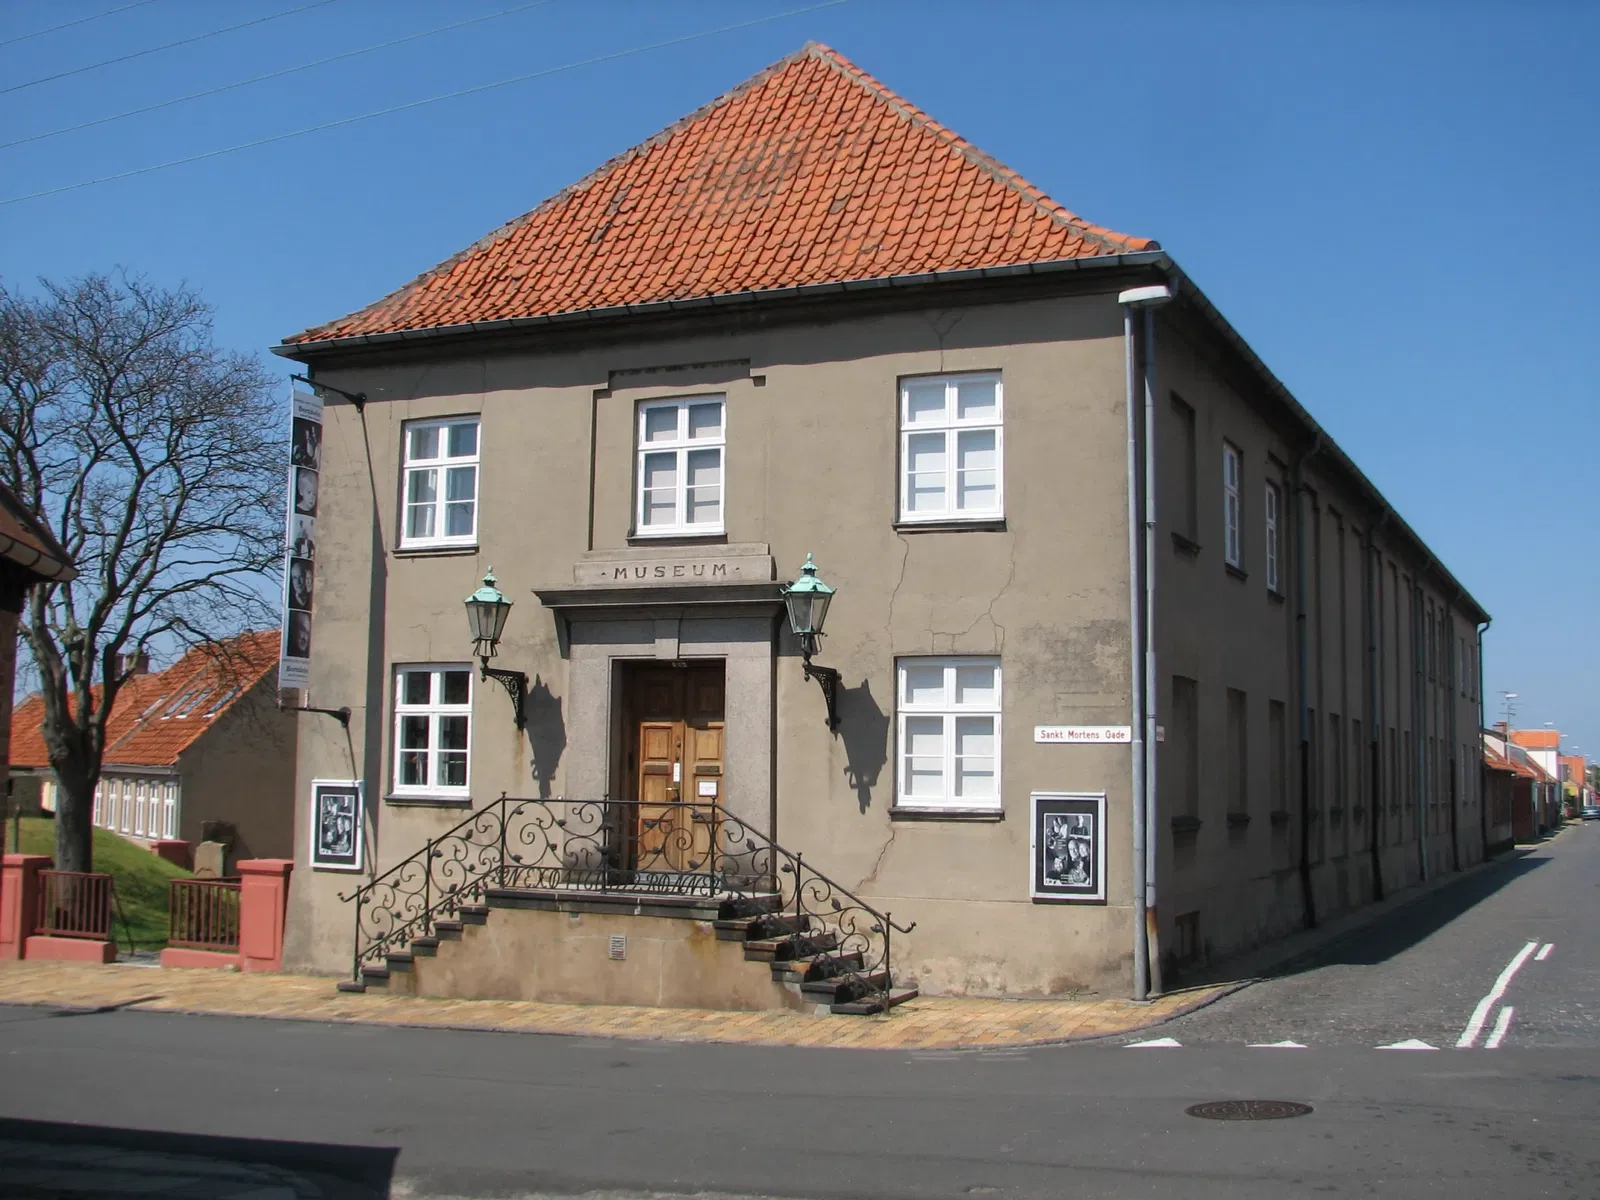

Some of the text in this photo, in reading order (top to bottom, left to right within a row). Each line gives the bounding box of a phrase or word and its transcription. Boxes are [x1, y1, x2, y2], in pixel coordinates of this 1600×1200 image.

[613, 563, 727, 580] MUSEUM
[1040, 729, 1125, 739] Sankt Mortens Gade
